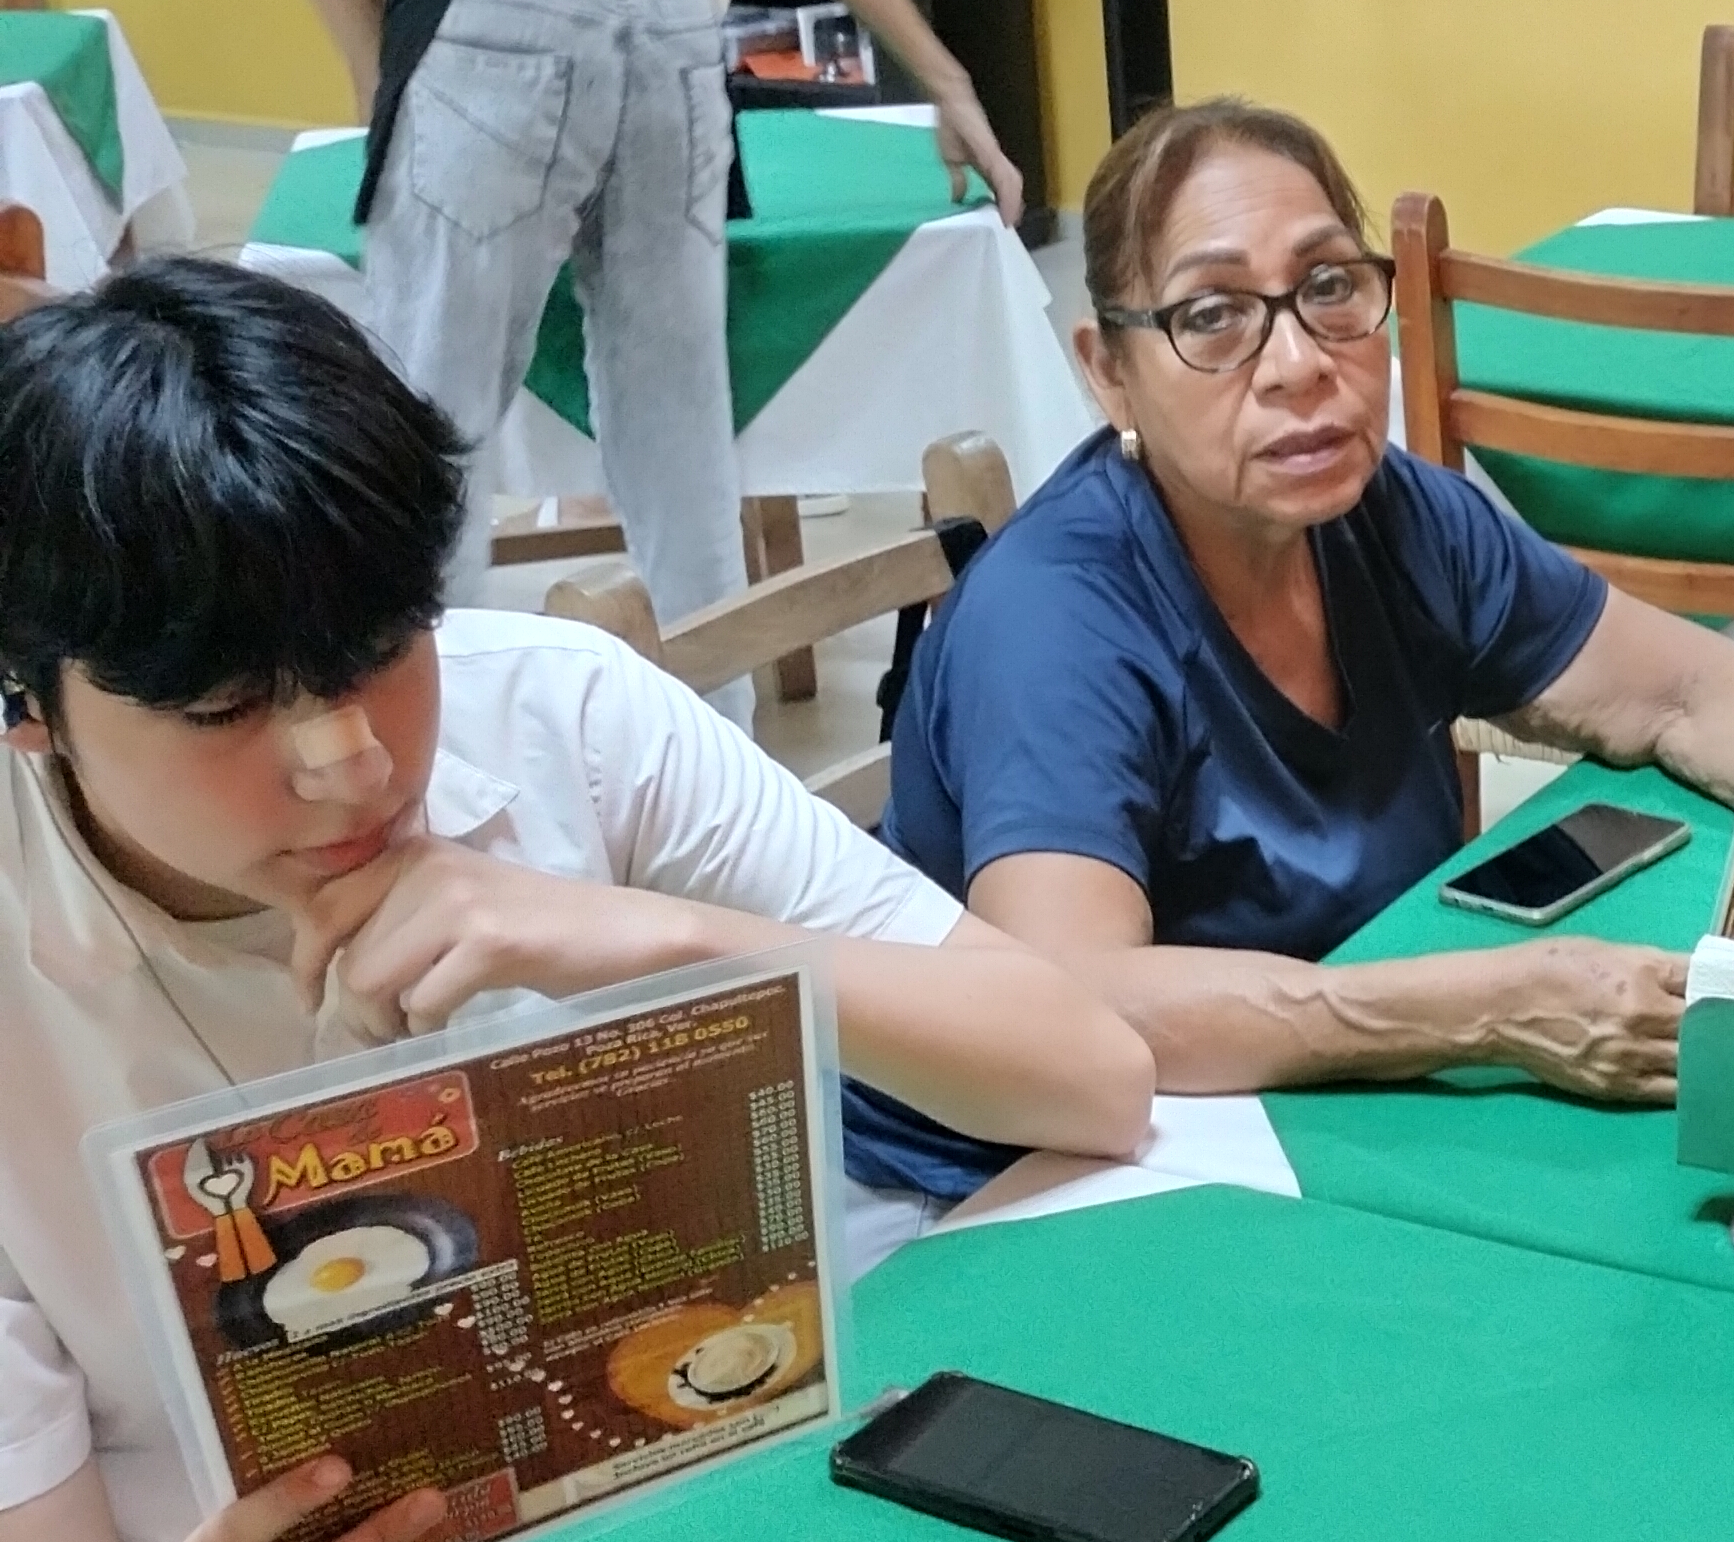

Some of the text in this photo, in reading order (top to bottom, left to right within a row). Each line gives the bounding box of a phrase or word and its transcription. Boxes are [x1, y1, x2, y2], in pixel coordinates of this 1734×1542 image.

[530, 1067, 573, 1086] Tel.
[578, 1046, 641, 1075] (782)
[649, 1033, 689, 1054] 118
[694, 1015, 750, 1041] 0550
[262, 1111, 460, 1207] Mamá
